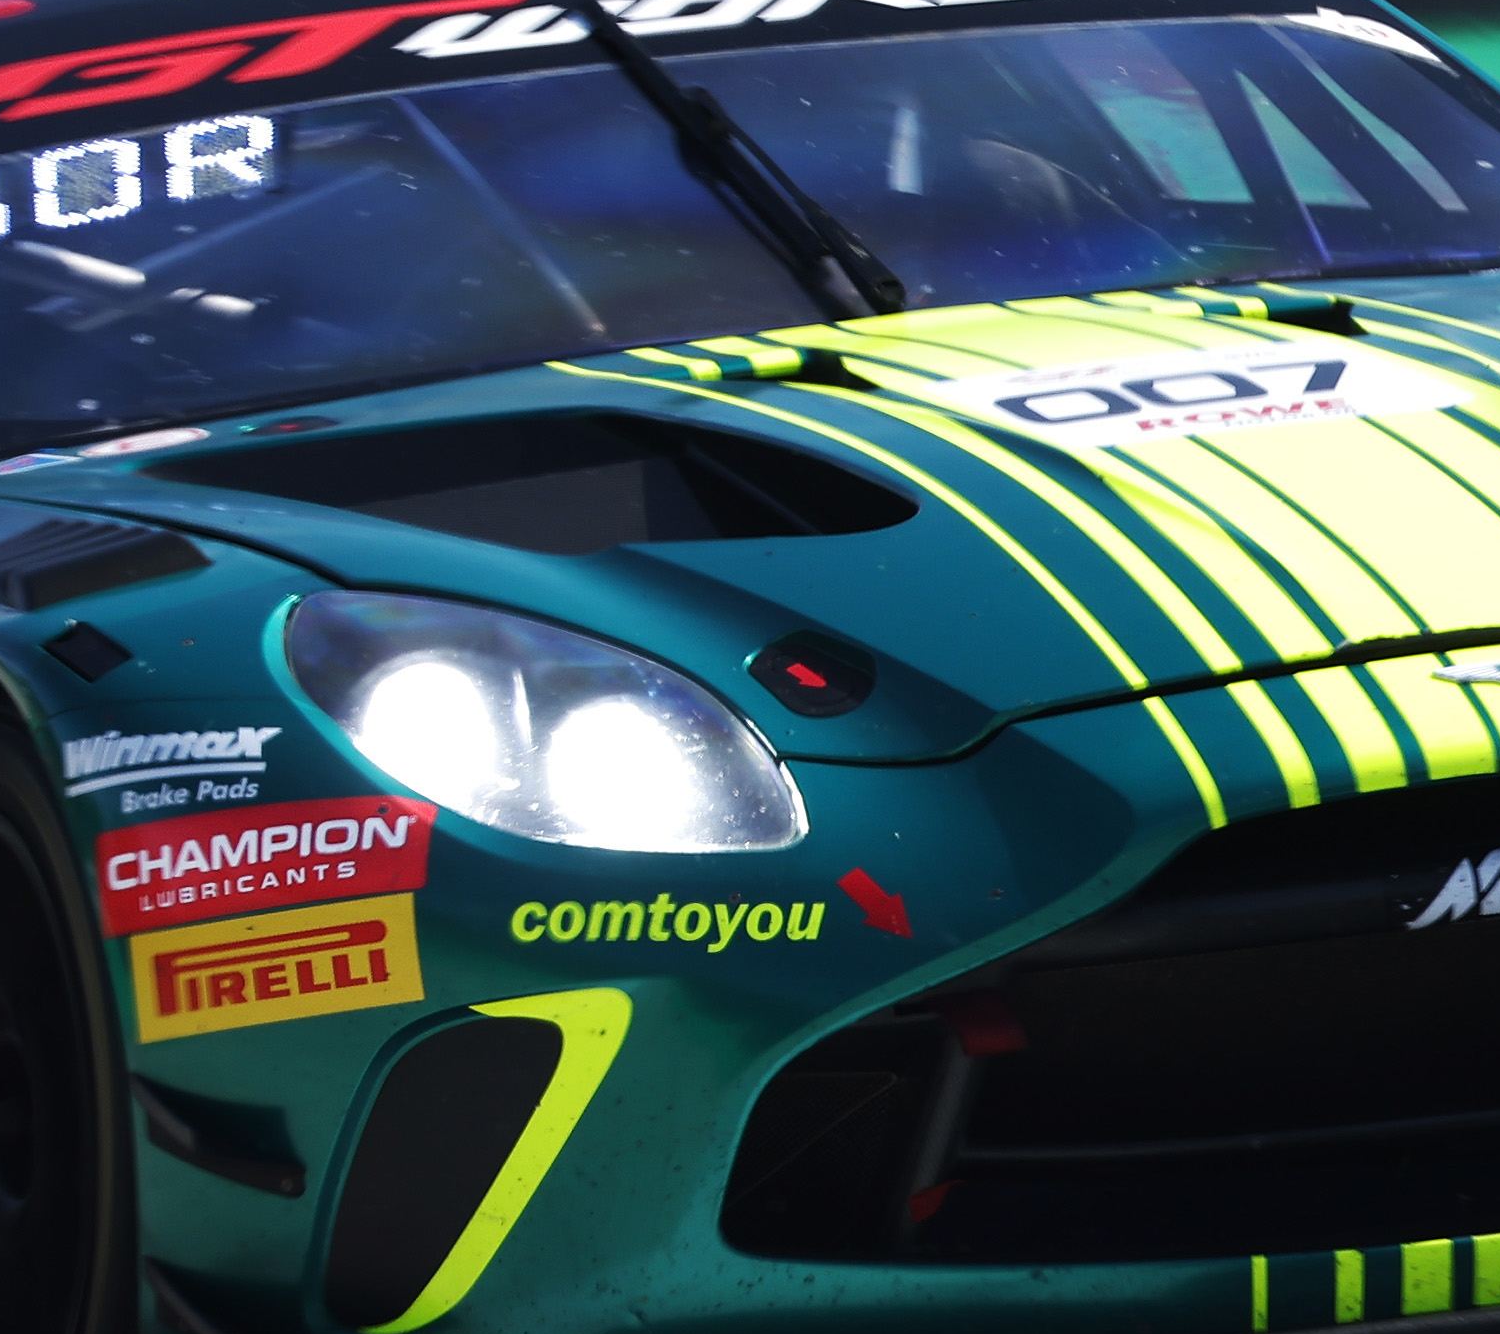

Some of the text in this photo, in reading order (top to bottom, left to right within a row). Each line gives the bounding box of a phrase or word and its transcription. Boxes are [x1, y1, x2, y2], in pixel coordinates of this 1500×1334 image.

[994, 358, 1348, 425] 007
[62, 726, 283, 779] Winmax
[120, 777, 259, 814] Brake Pads
[138, 860, 357, 912] LUBRICANTS
[510, 893, 826, 954] comtoyou
[151, 918, 391, 1017] PIRELLI
